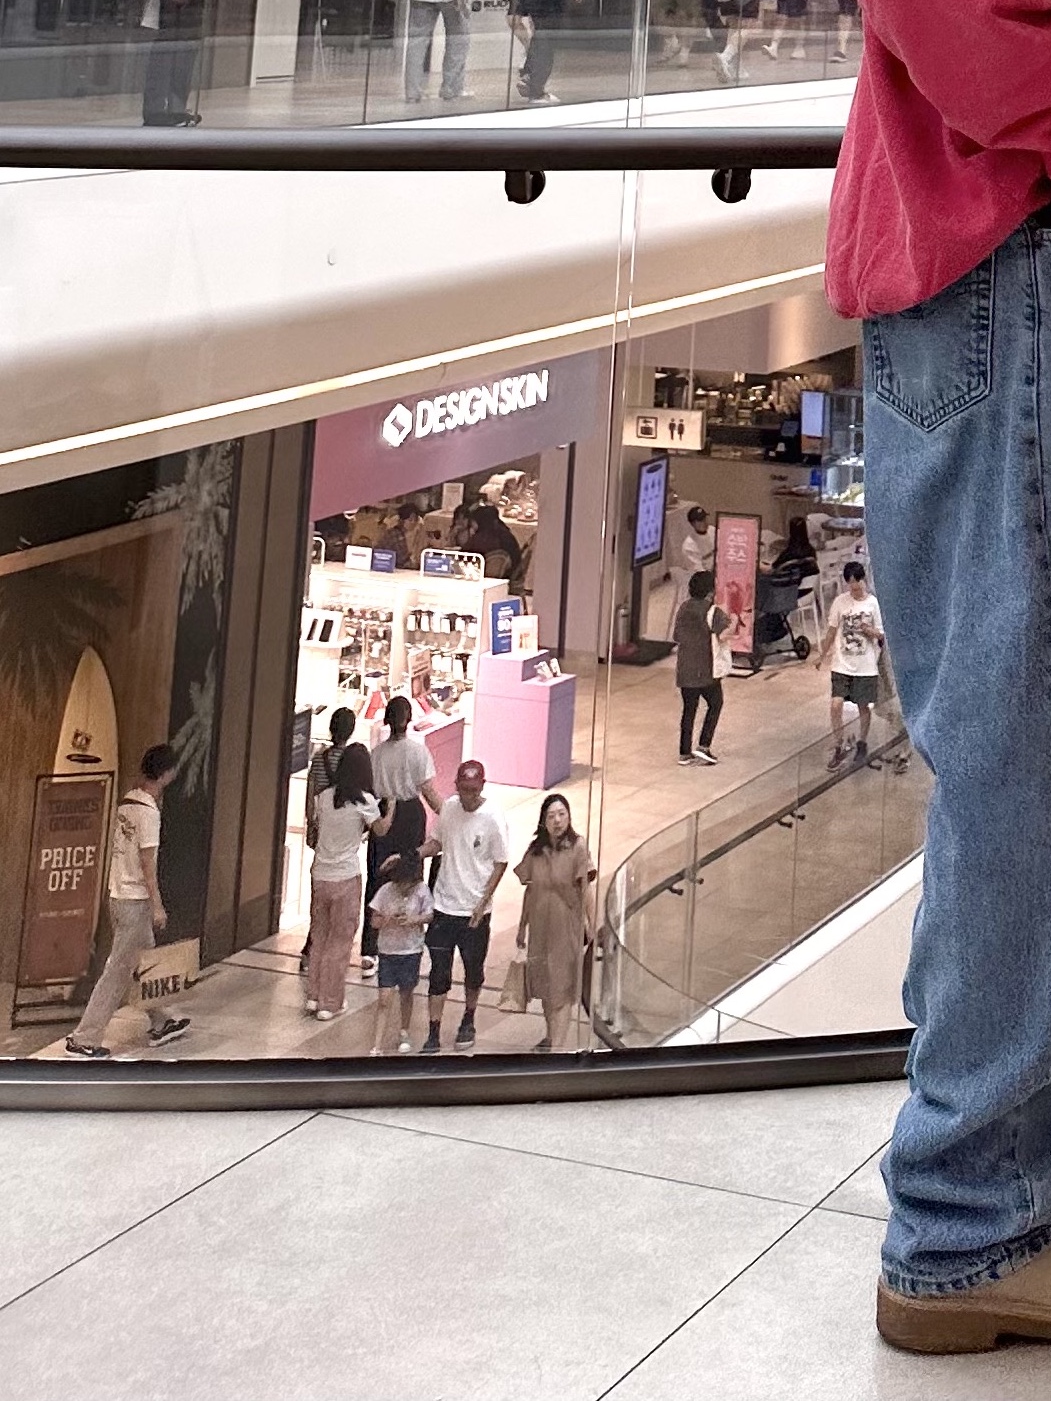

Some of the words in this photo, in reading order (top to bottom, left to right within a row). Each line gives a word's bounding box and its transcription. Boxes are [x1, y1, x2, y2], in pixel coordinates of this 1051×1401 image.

[414, 369, 549, 439] DESIGNSKIN
[40, 846, 96, 870] PRICE
[48, 869, 83, 892] OFF
[141, 974, 181, 1000] NIKE
